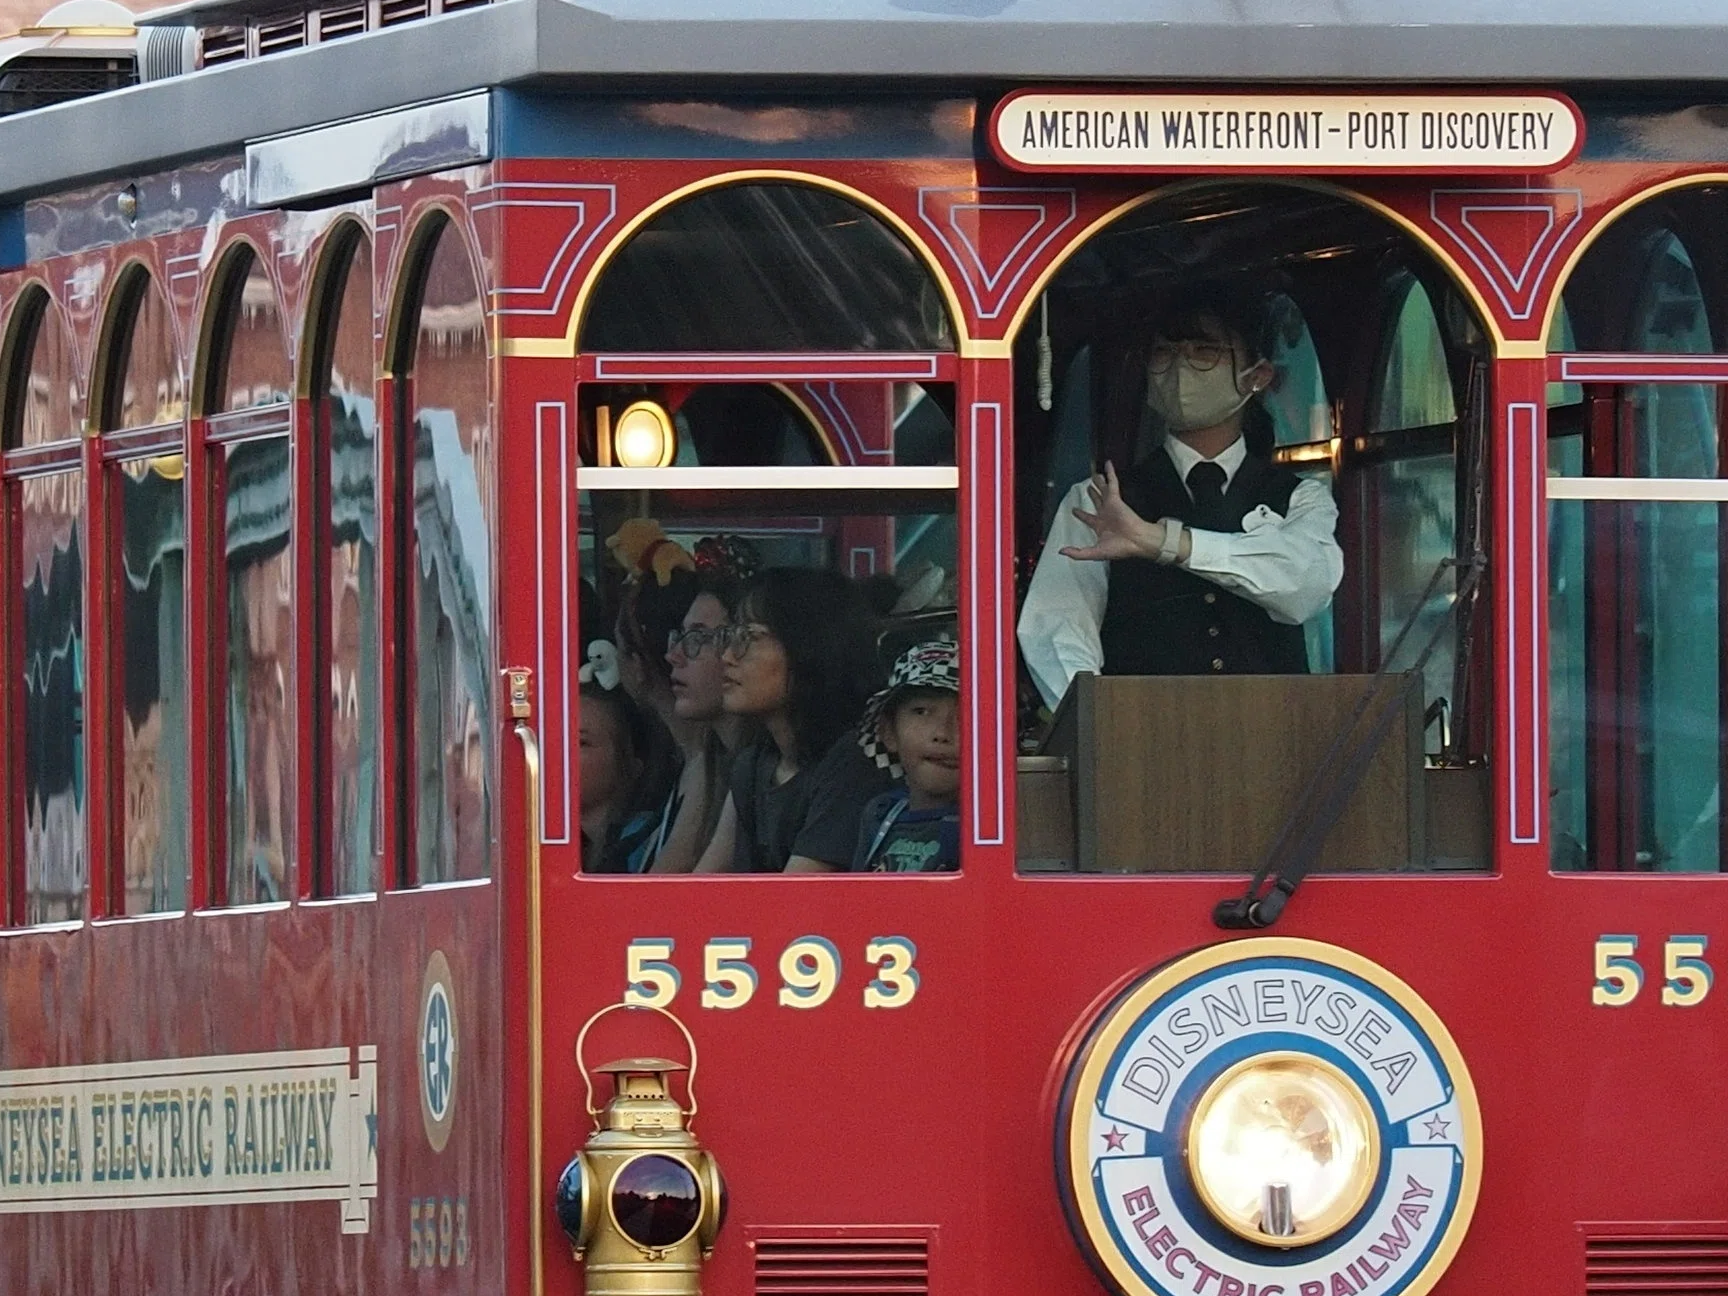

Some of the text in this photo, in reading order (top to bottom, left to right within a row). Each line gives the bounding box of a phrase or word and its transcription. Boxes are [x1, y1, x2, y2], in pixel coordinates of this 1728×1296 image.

[1021, 109, 1150, 151] AMERICAN
[1421, 109, 1555, 151] DISCOVERY
[622, 935, 921, 1010] 5593
[1122, 979, 1418, 1105] DISNEYSEA
[90, 1084, 214, 1182] ELECTRIC
[224, 1078, 336, 1176] RAILWAY
[409, 1196, 469, 1269] 5593
